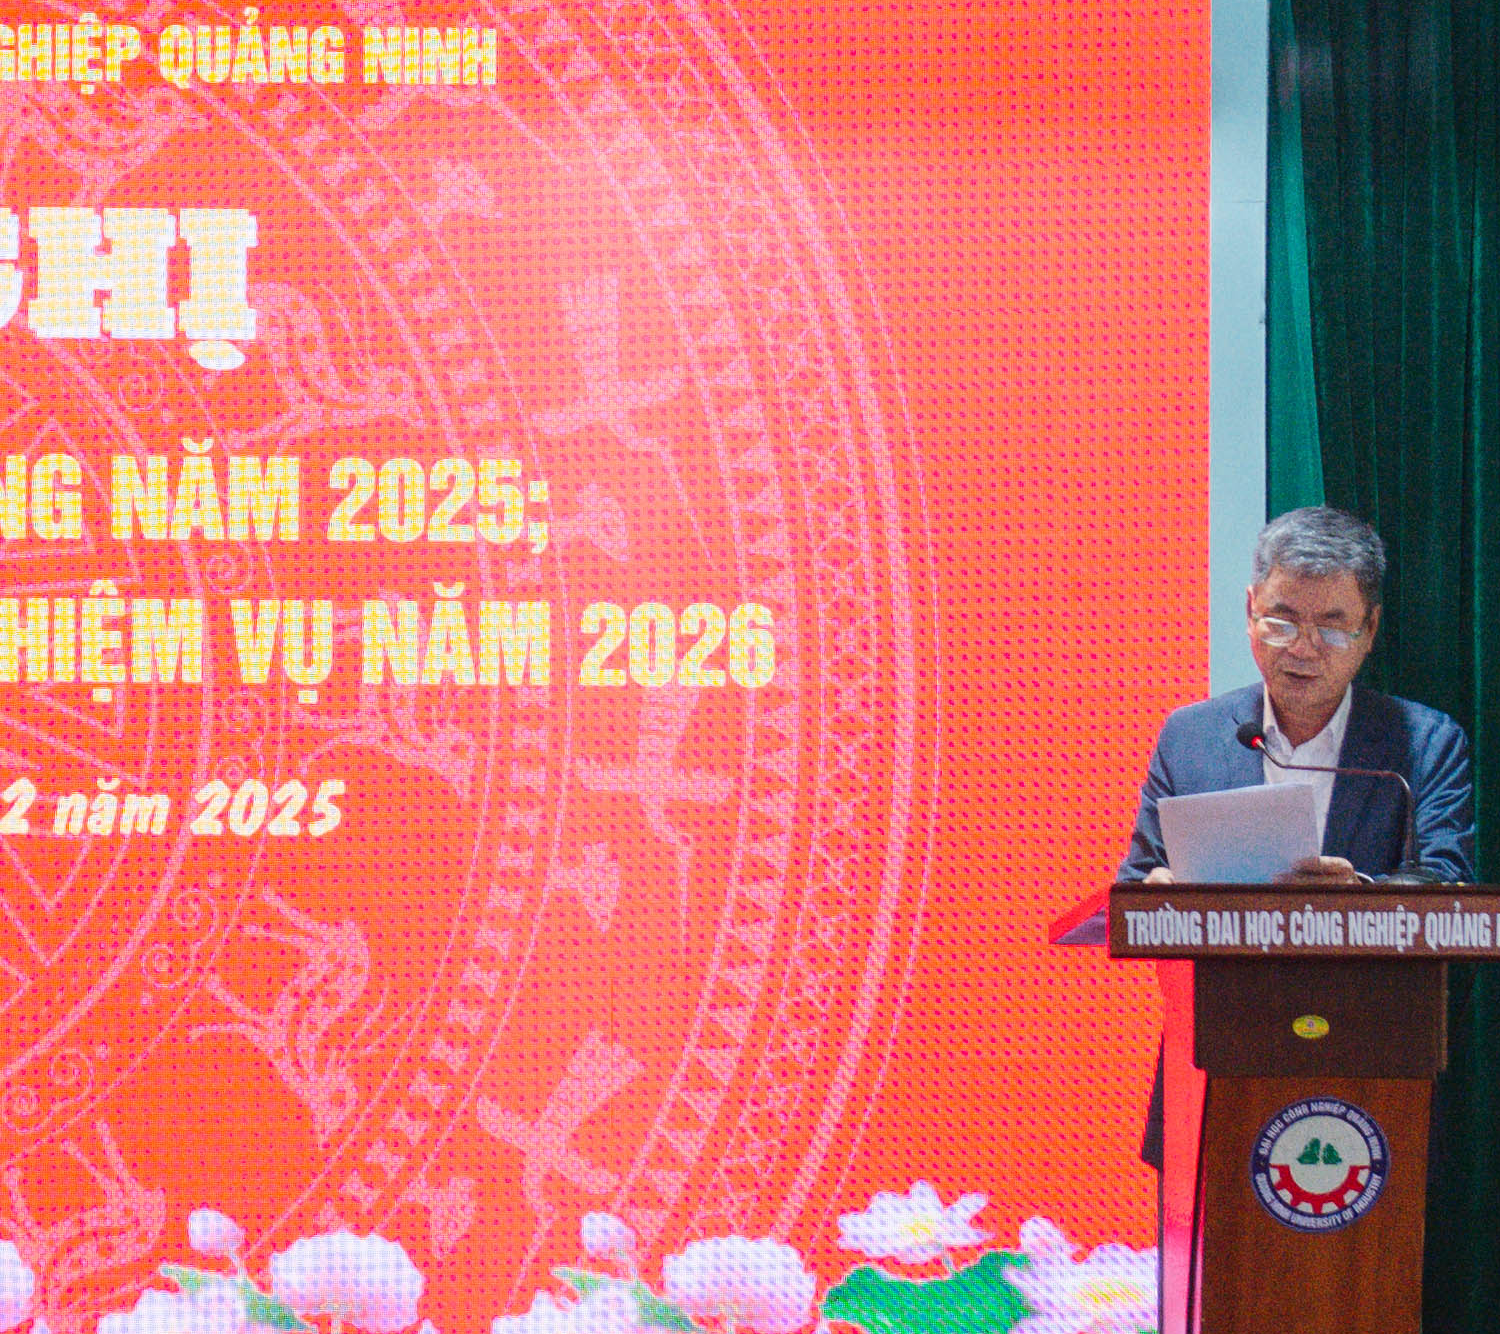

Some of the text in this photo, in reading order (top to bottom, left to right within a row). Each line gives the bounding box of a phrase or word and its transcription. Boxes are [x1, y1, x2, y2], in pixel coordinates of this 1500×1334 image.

[161, 8, 343, 88] QUẢNG
[365, 28, 496, 85] NINH
[113, 438, 298, 540] NĂM
[329, 458, 548, 553] 2025;
[232, 600, 332, 703] VỤ
[363, 583, 550, 685] NĂM
[580, 602, 775, 688] 2026
[54, 779, 169, 834] năm
[191, 780, 344, 835] 2025
[1124, 902, 1202, 946] TRƯỜNG
[1245, 910, 1285, 953] HỌC
[1289, 904, 1344, 946] CÔNG
[1348, 904, 1420, 952] NGHIỆP
[1425, 901, 1491, 951] QUẢNG
